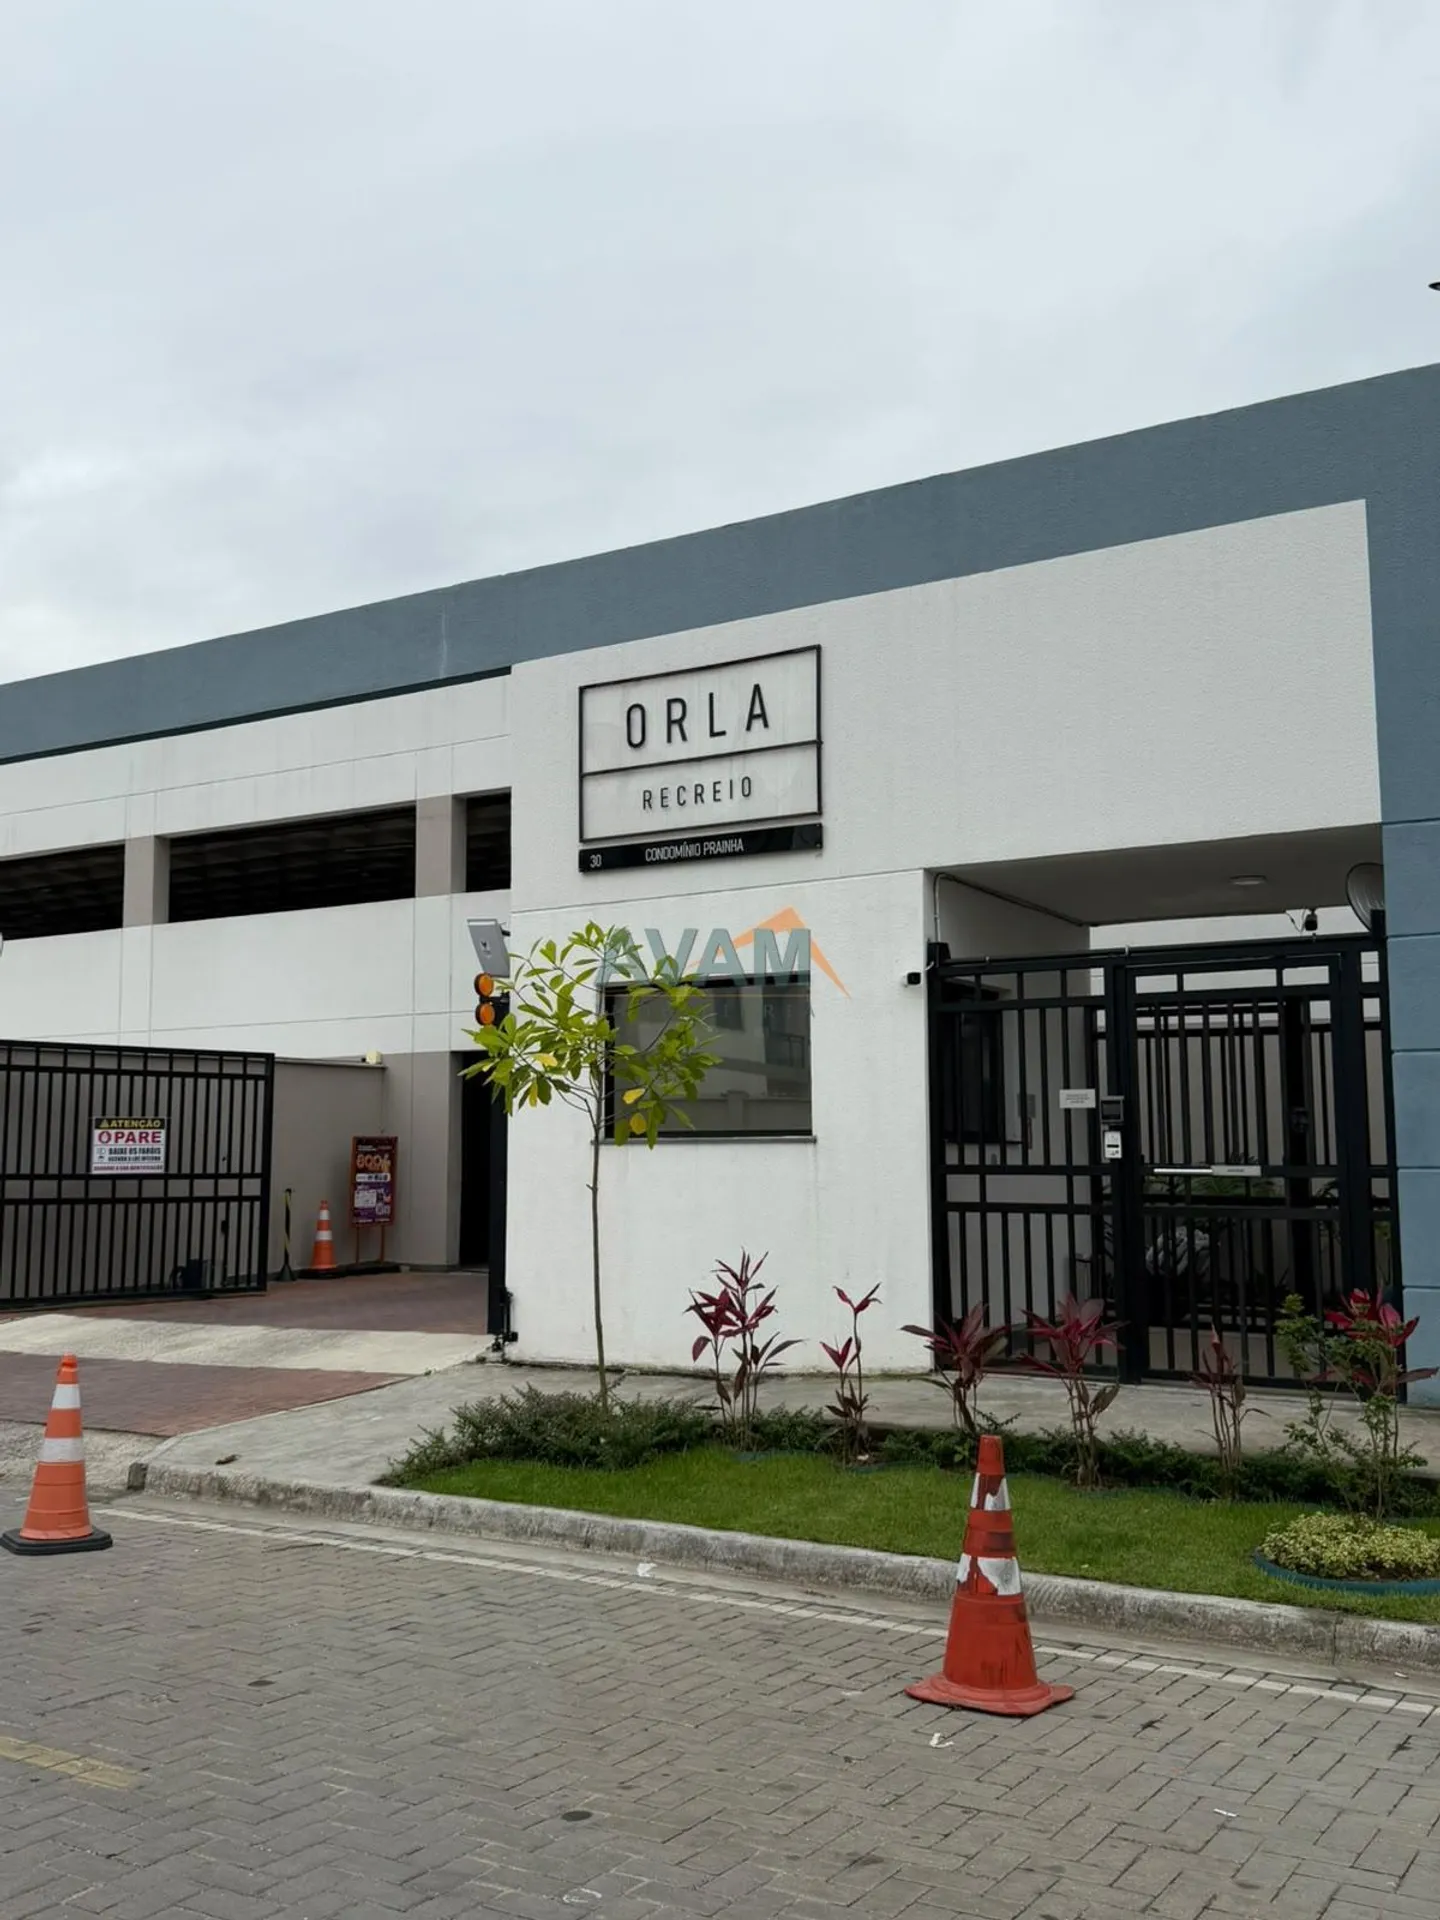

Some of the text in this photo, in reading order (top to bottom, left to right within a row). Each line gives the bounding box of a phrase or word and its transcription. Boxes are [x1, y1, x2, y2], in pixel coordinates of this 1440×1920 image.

[626, 683, 769, 749] ORLA
[642, 776, 752, 810] RECREIO
[645, 838, 744, 861] CONDOMÍNIO PRAINHA
[590, 854, 602, 867] 30
[110, 1119, 161, 1128] ATENÇÃO
[114, 1131, 162, 1143] PARE
